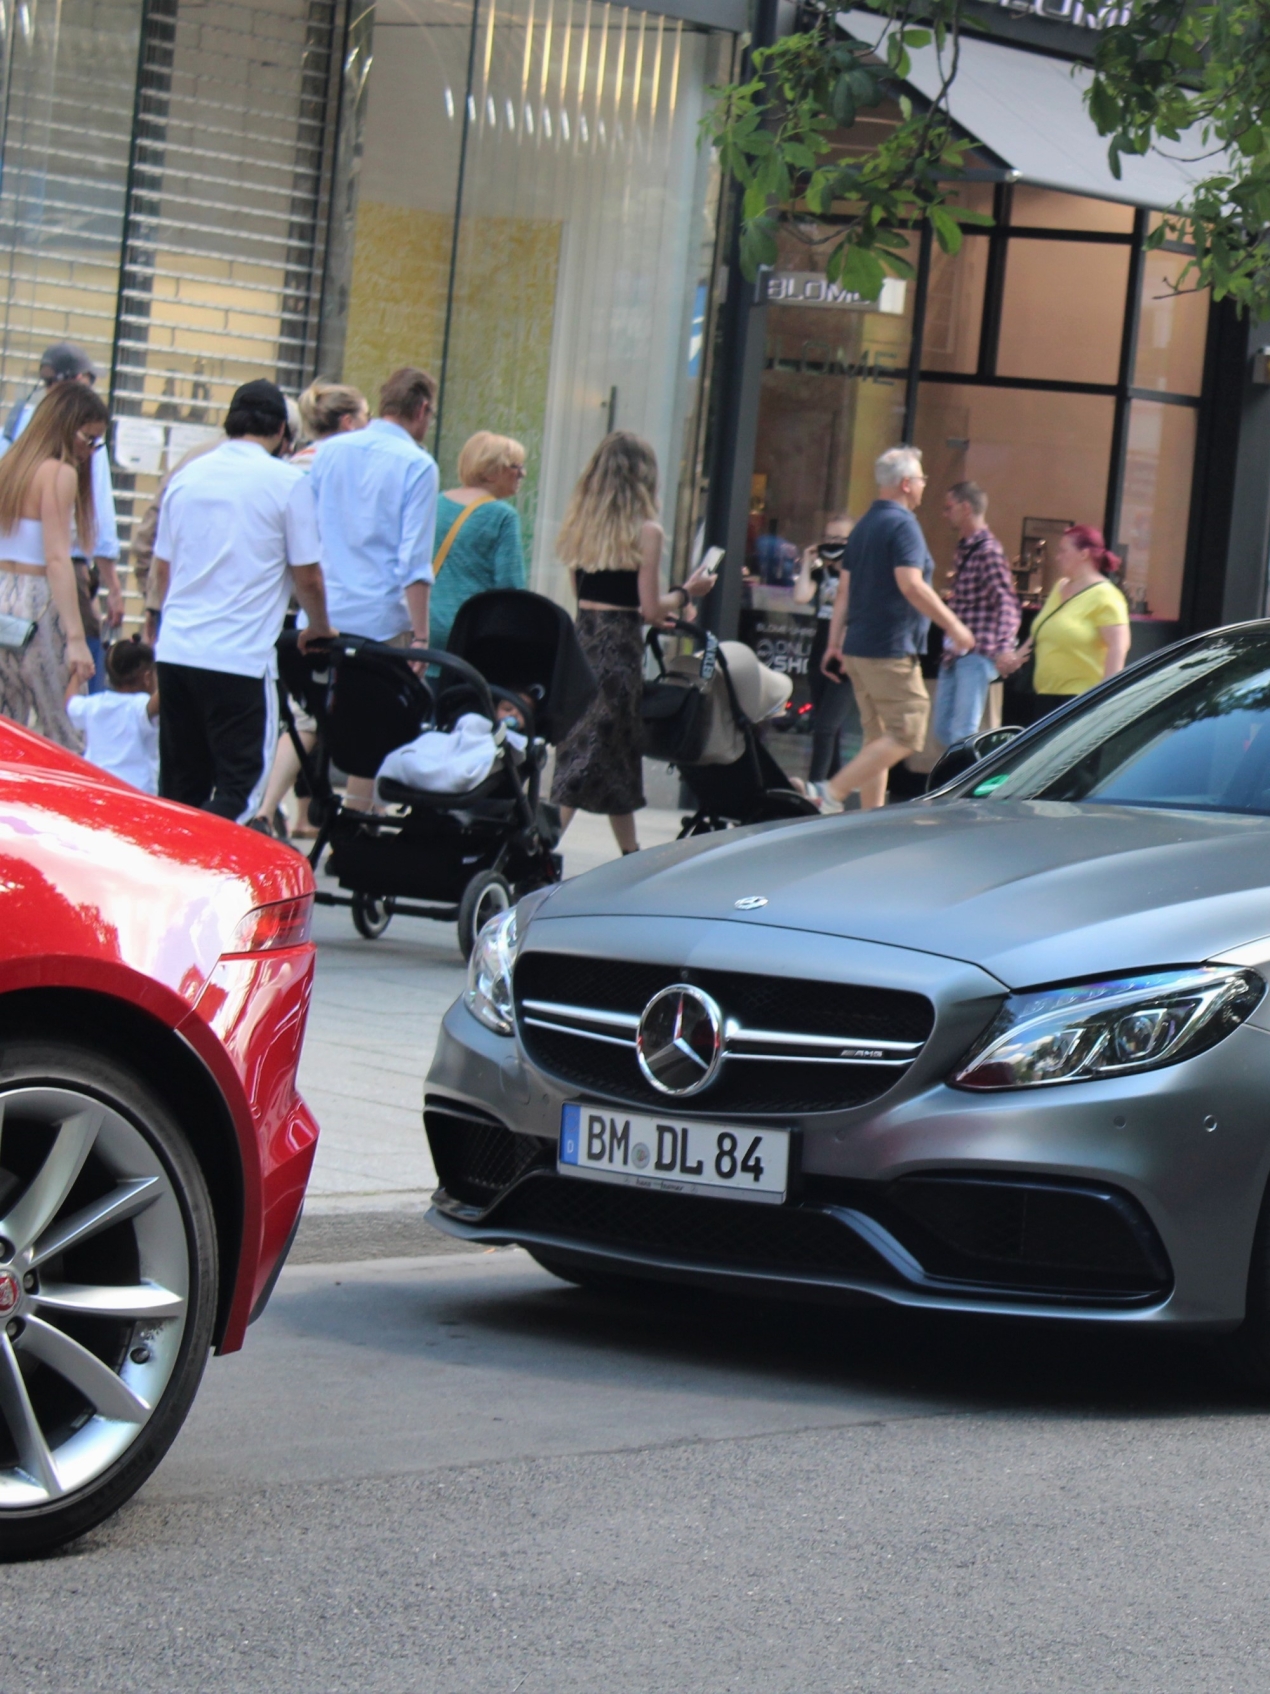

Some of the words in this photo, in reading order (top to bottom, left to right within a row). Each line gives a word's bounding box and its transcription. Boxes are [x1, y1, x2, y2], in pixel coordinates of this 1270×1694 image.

[566, 1140, 574, 1154] D
[587, 1115, 631, 1166] BM
[654, 1124, 704, 1176] DL
[714, 1131, 766, 1183] 84
